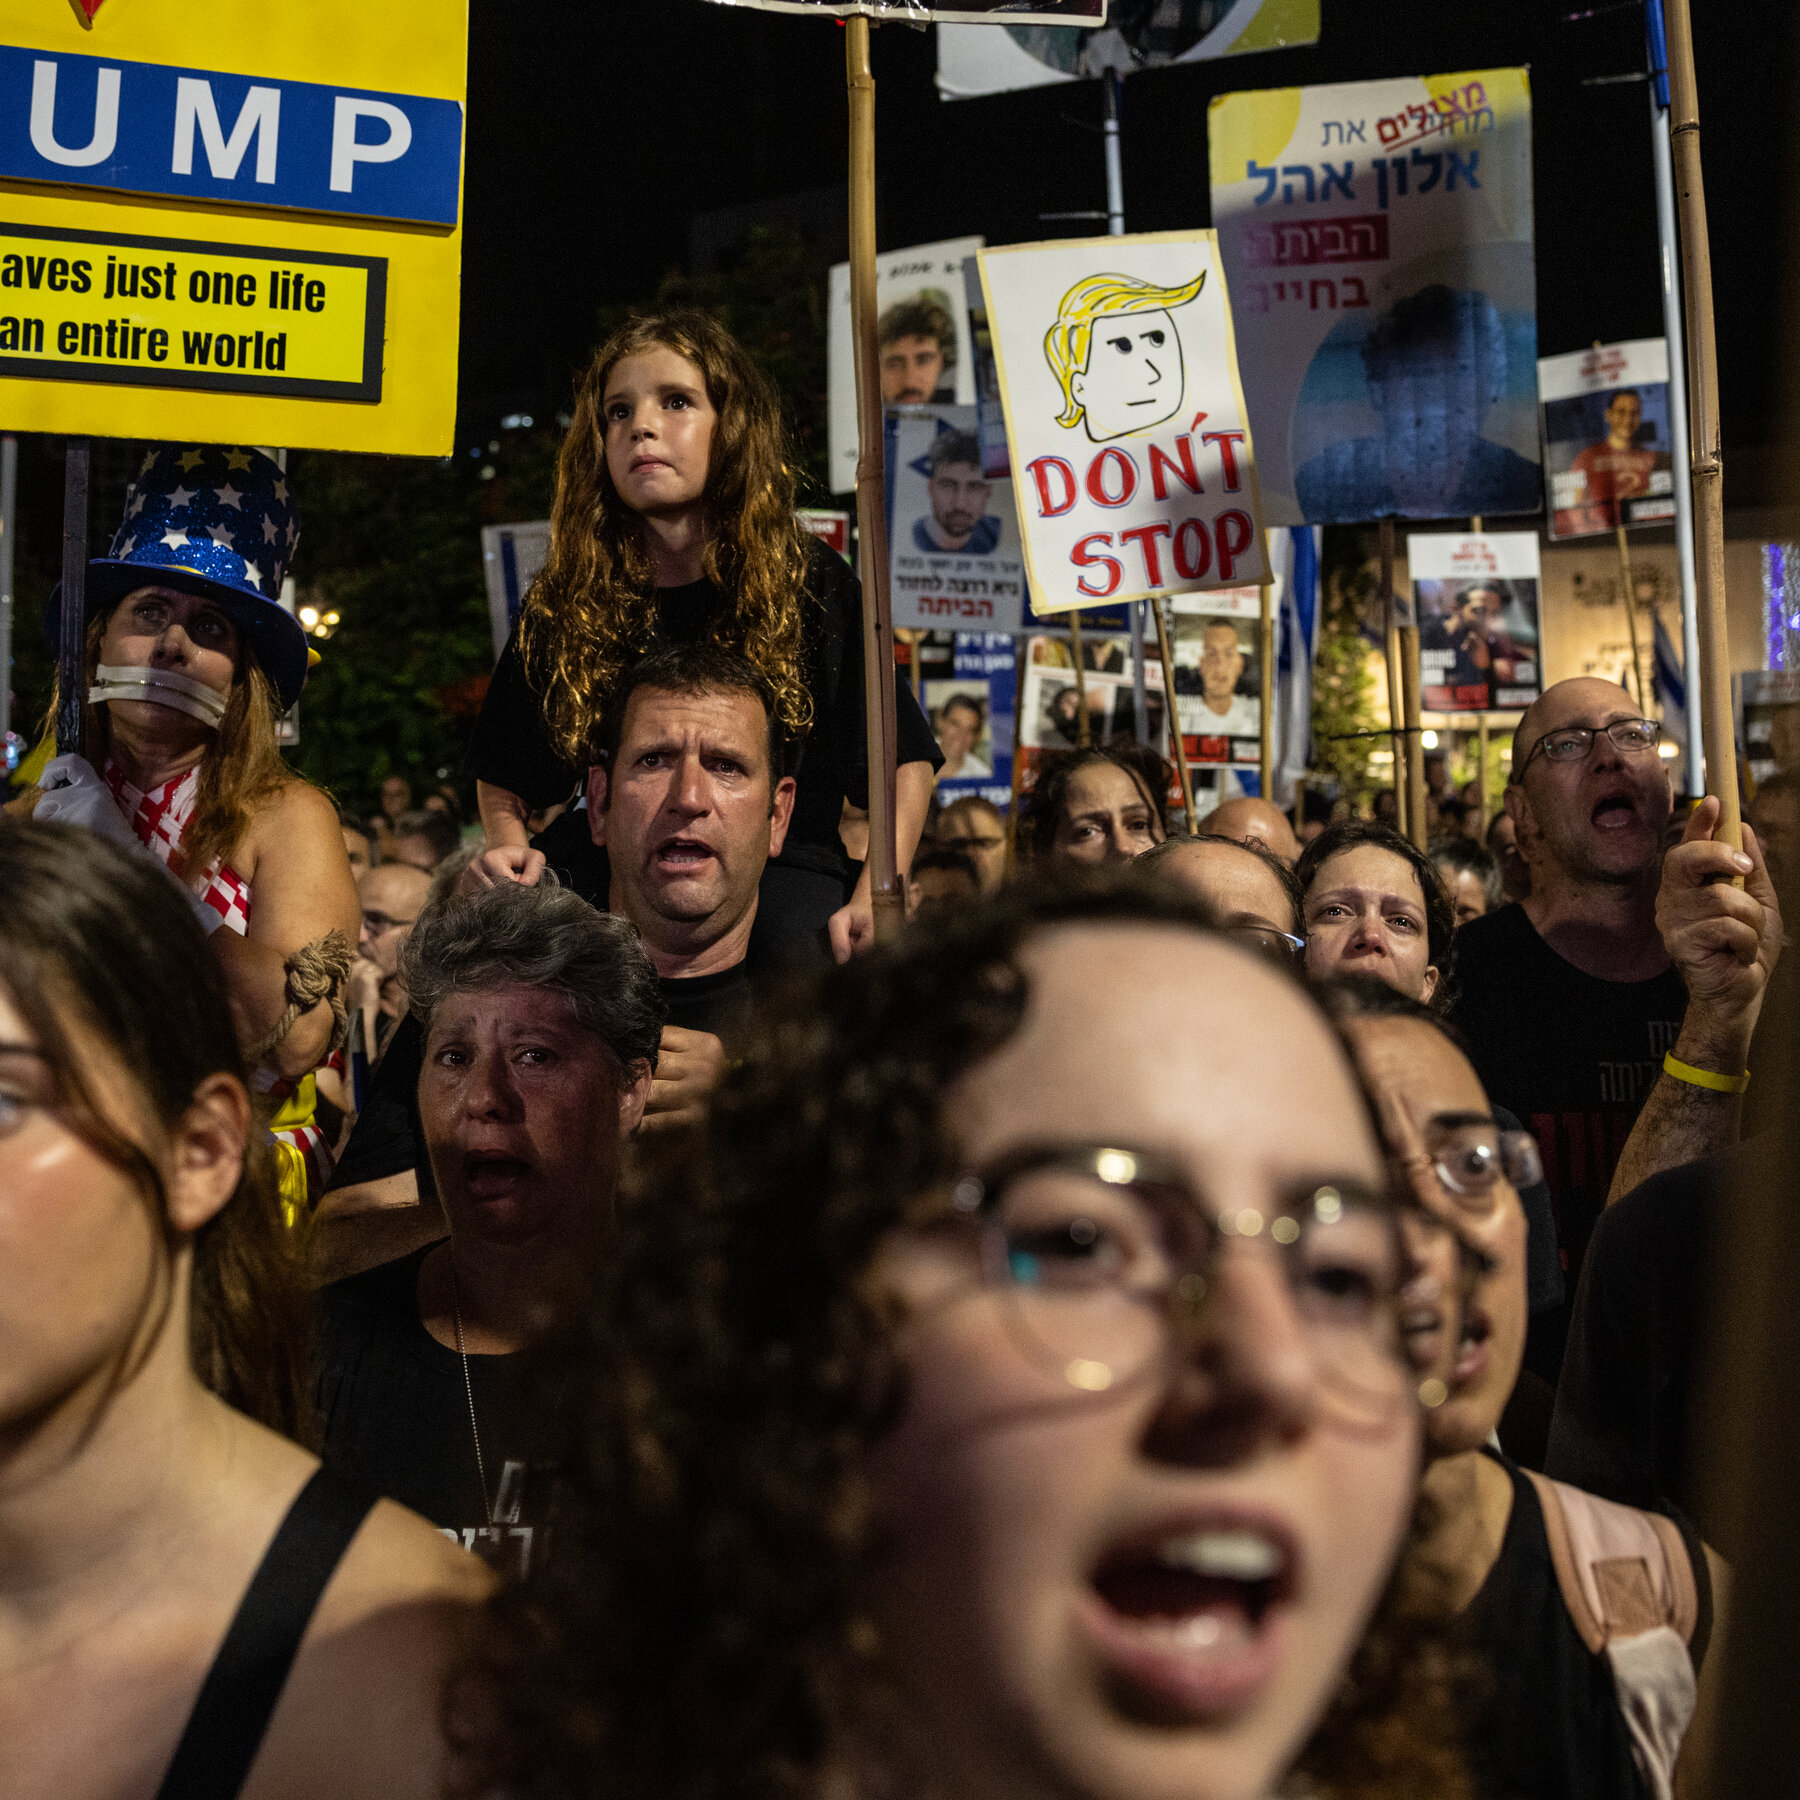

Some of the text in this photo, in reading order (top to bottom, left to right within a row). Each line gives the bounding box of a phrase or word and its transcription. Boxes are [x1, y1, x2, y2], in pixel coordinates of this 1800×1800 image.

[29, 60, 413, 193] UMP
[1321, 119, 1367, 146] את
[1247, 148, 1482, 210] אלון אהל
[1, 253, 327, 313] aves just one life
[0, 316, 288, 371] an entire world
[1026, 412, 1246, 517] DON'T
[1070, 509, 1254, 597] STOP
[918, 596, 994, 618] הביתה
